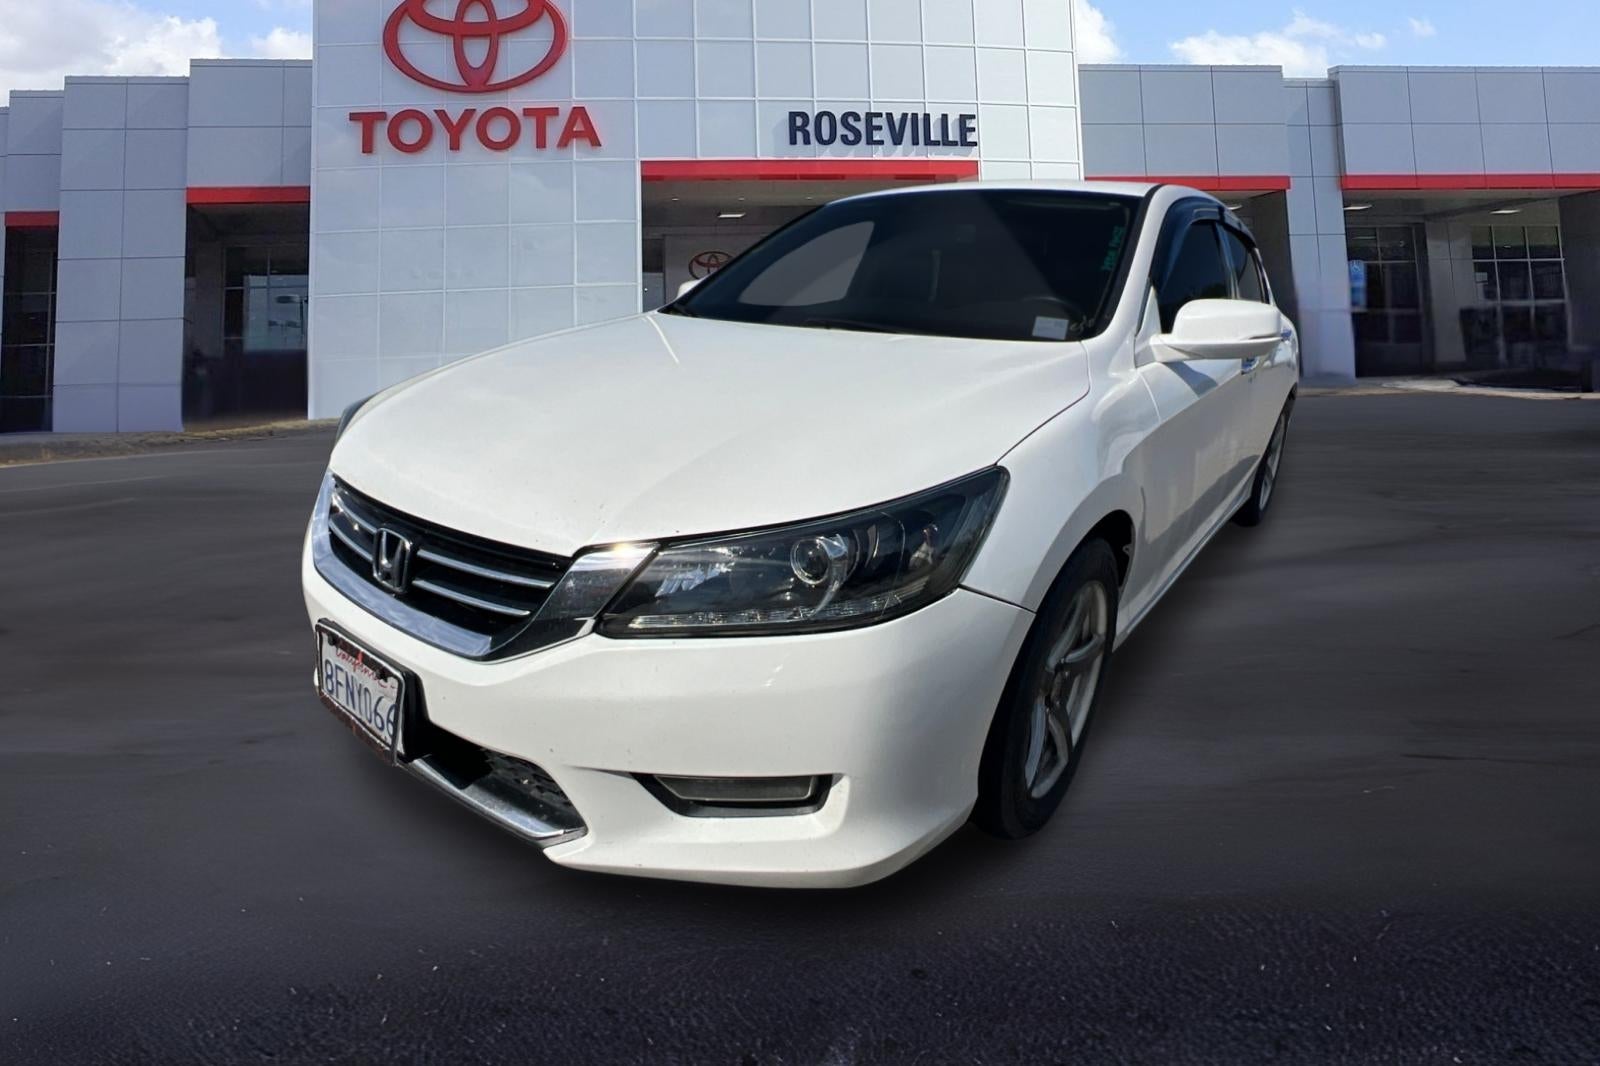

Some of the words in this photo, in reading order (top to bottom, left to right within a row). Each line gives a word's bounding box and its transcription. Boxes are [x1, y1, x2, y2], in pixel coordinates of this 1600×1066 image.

[349, 106, 602, 154] TOYOTA
[788, 111, 978, 147] ROSEVILLE
[325, 659, 398, 740] 8FNY066
